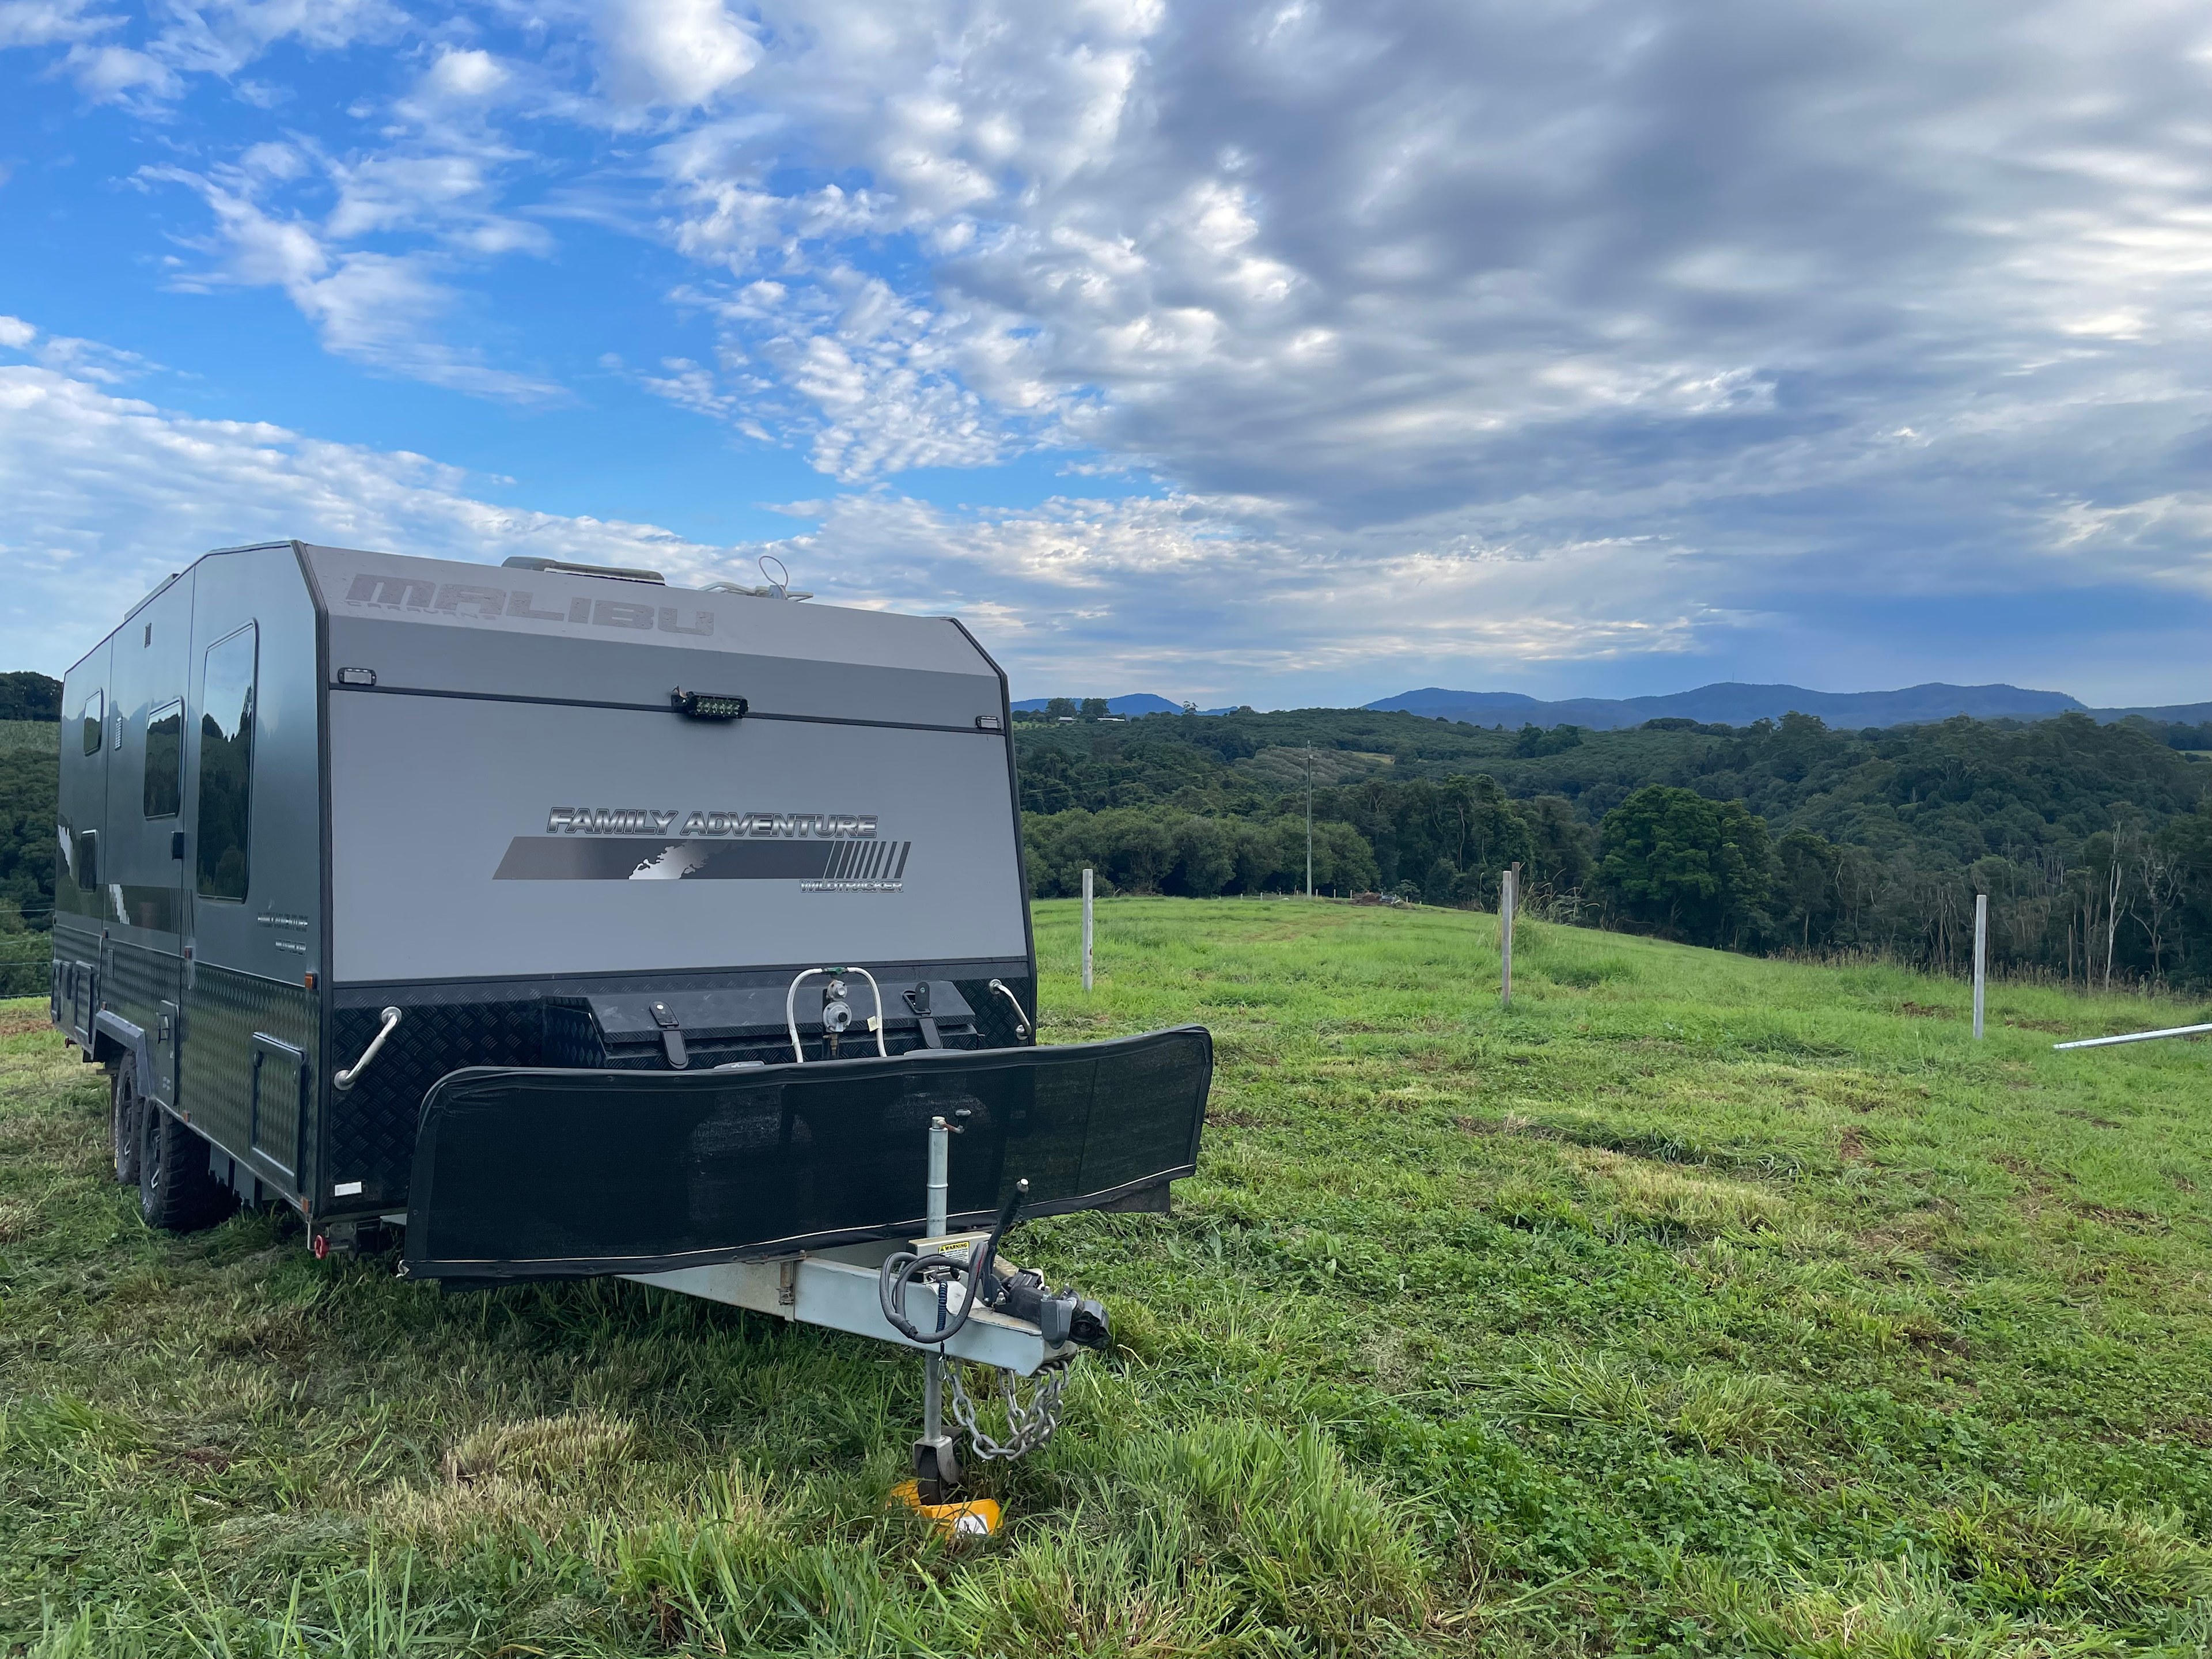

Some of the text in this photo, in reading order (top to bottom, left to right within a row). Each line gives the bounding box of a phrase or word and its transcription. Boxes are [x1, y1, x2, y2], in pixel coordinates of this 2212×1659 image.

[346, 574, 714, 636] MALIBU
[547, 806, 878, 839] FAMILY ADVENTURE
[800, 880, 903, 893] WILDTRACKER
